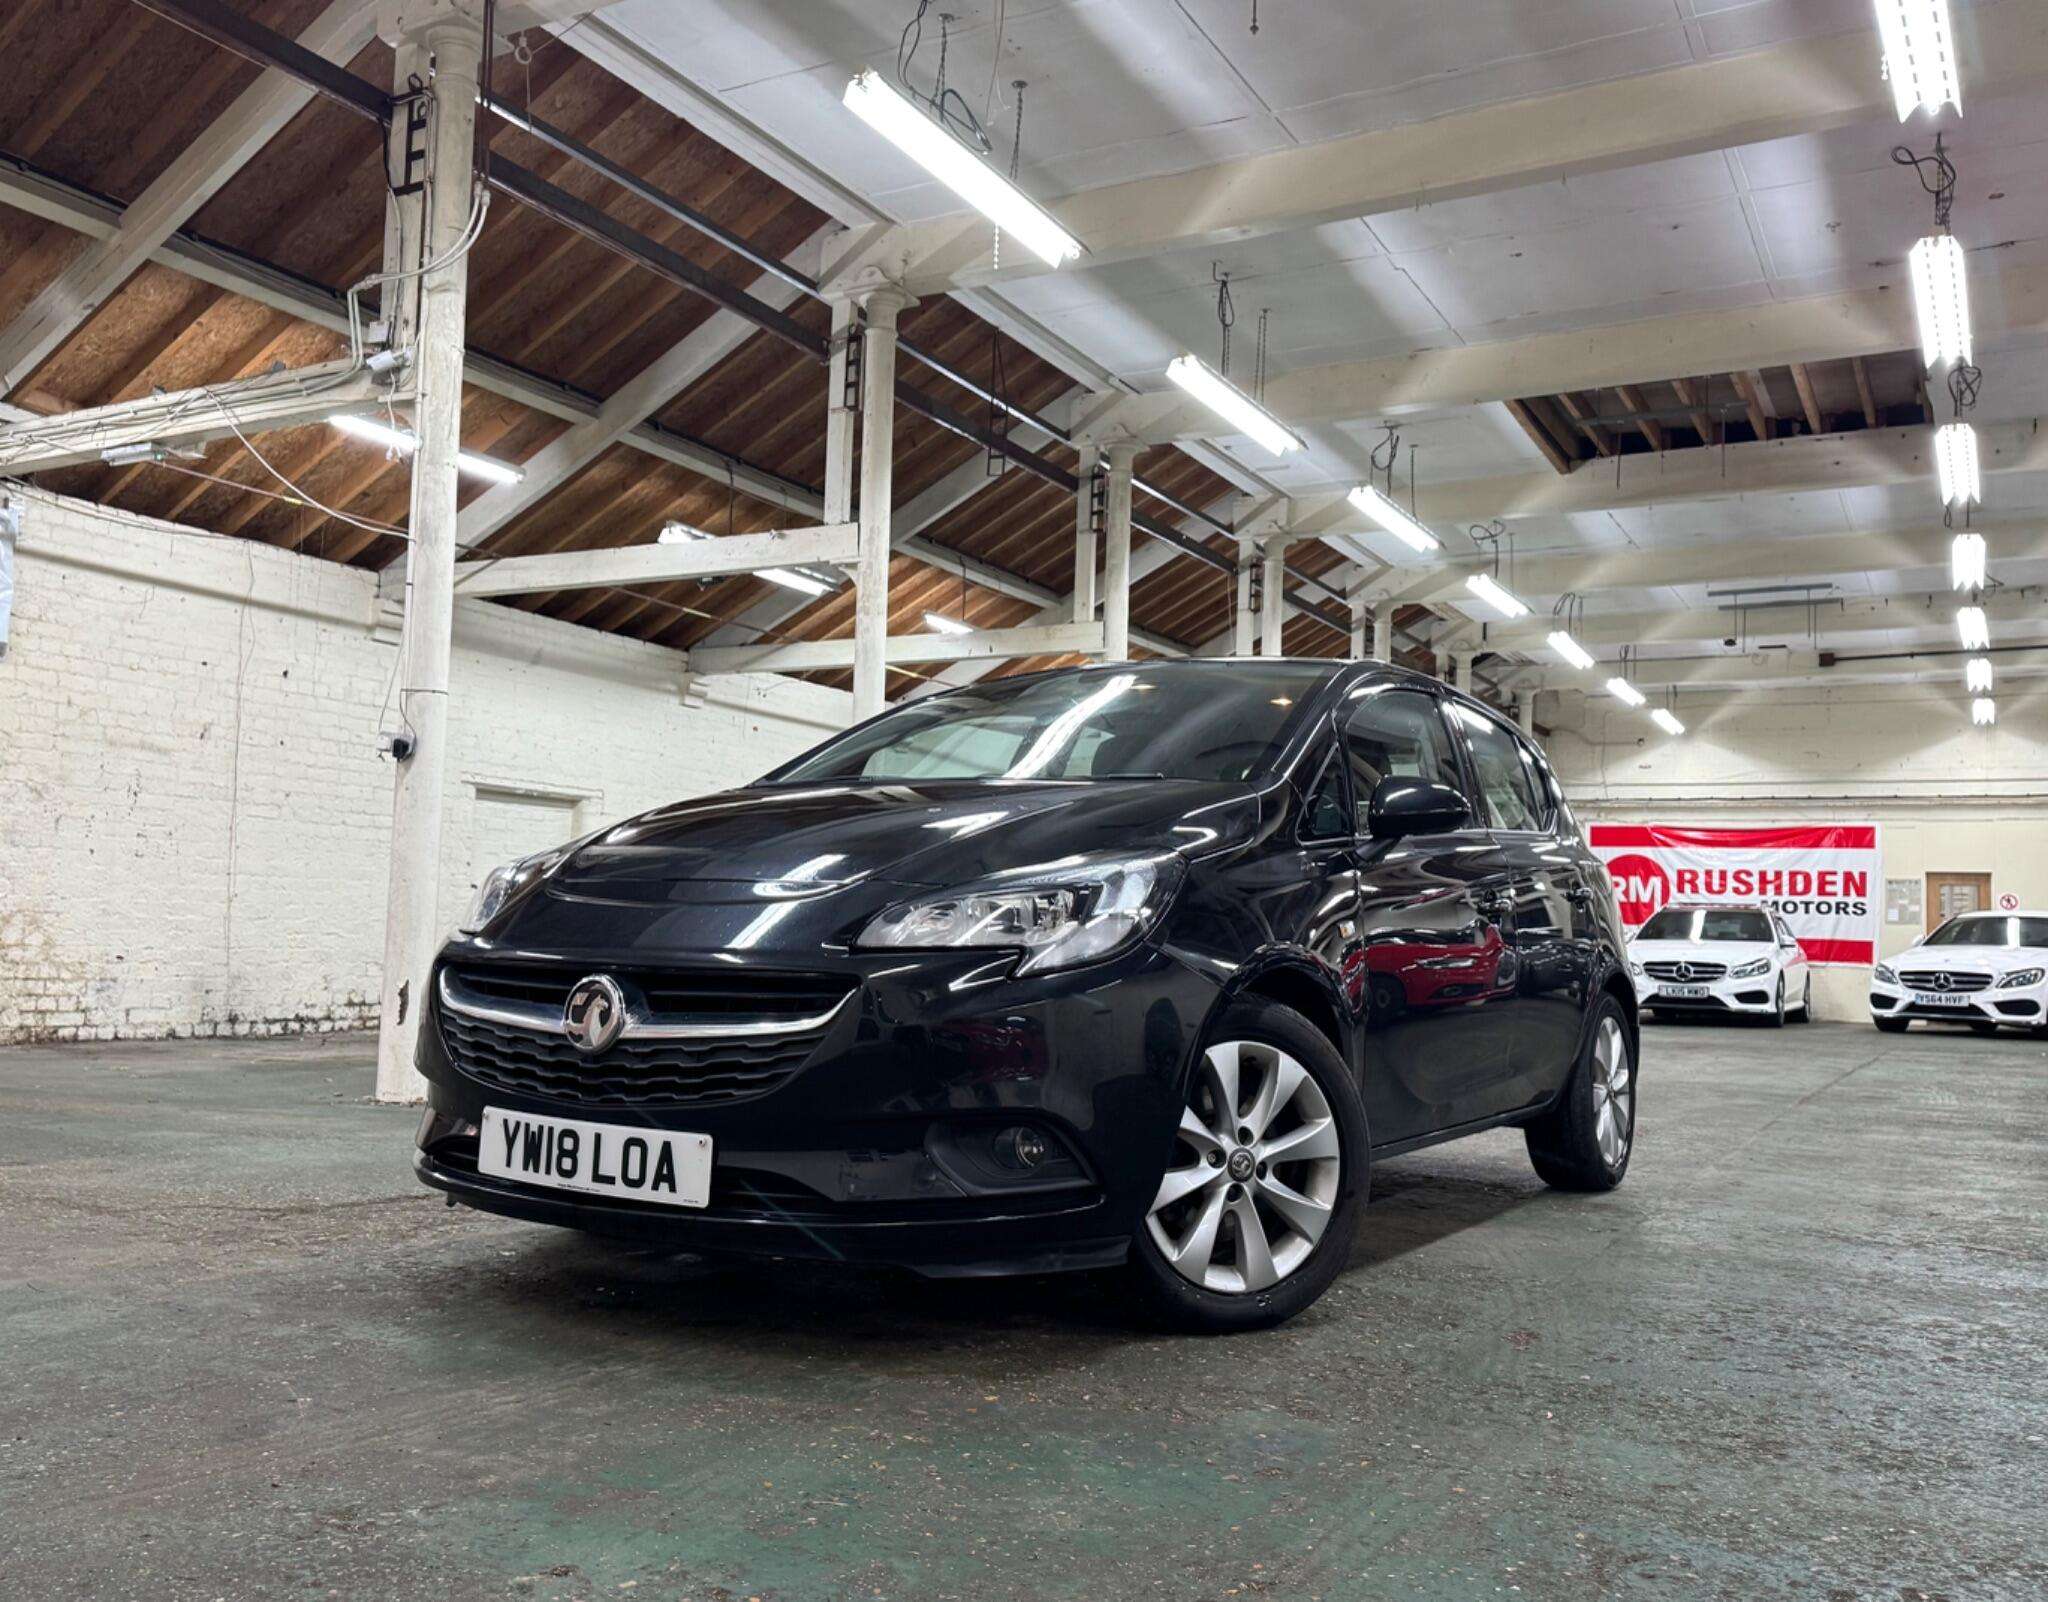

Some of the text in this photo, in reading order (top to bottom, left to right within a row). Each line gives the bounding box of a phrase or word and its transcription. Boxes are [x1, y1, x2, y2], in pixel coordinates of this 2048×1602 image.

[1611, 875, 1662, 910] RM
[1676, 868, 1867, 898] RUSHDEN
[502, 1118, 677, 1194] YW18 LOA
